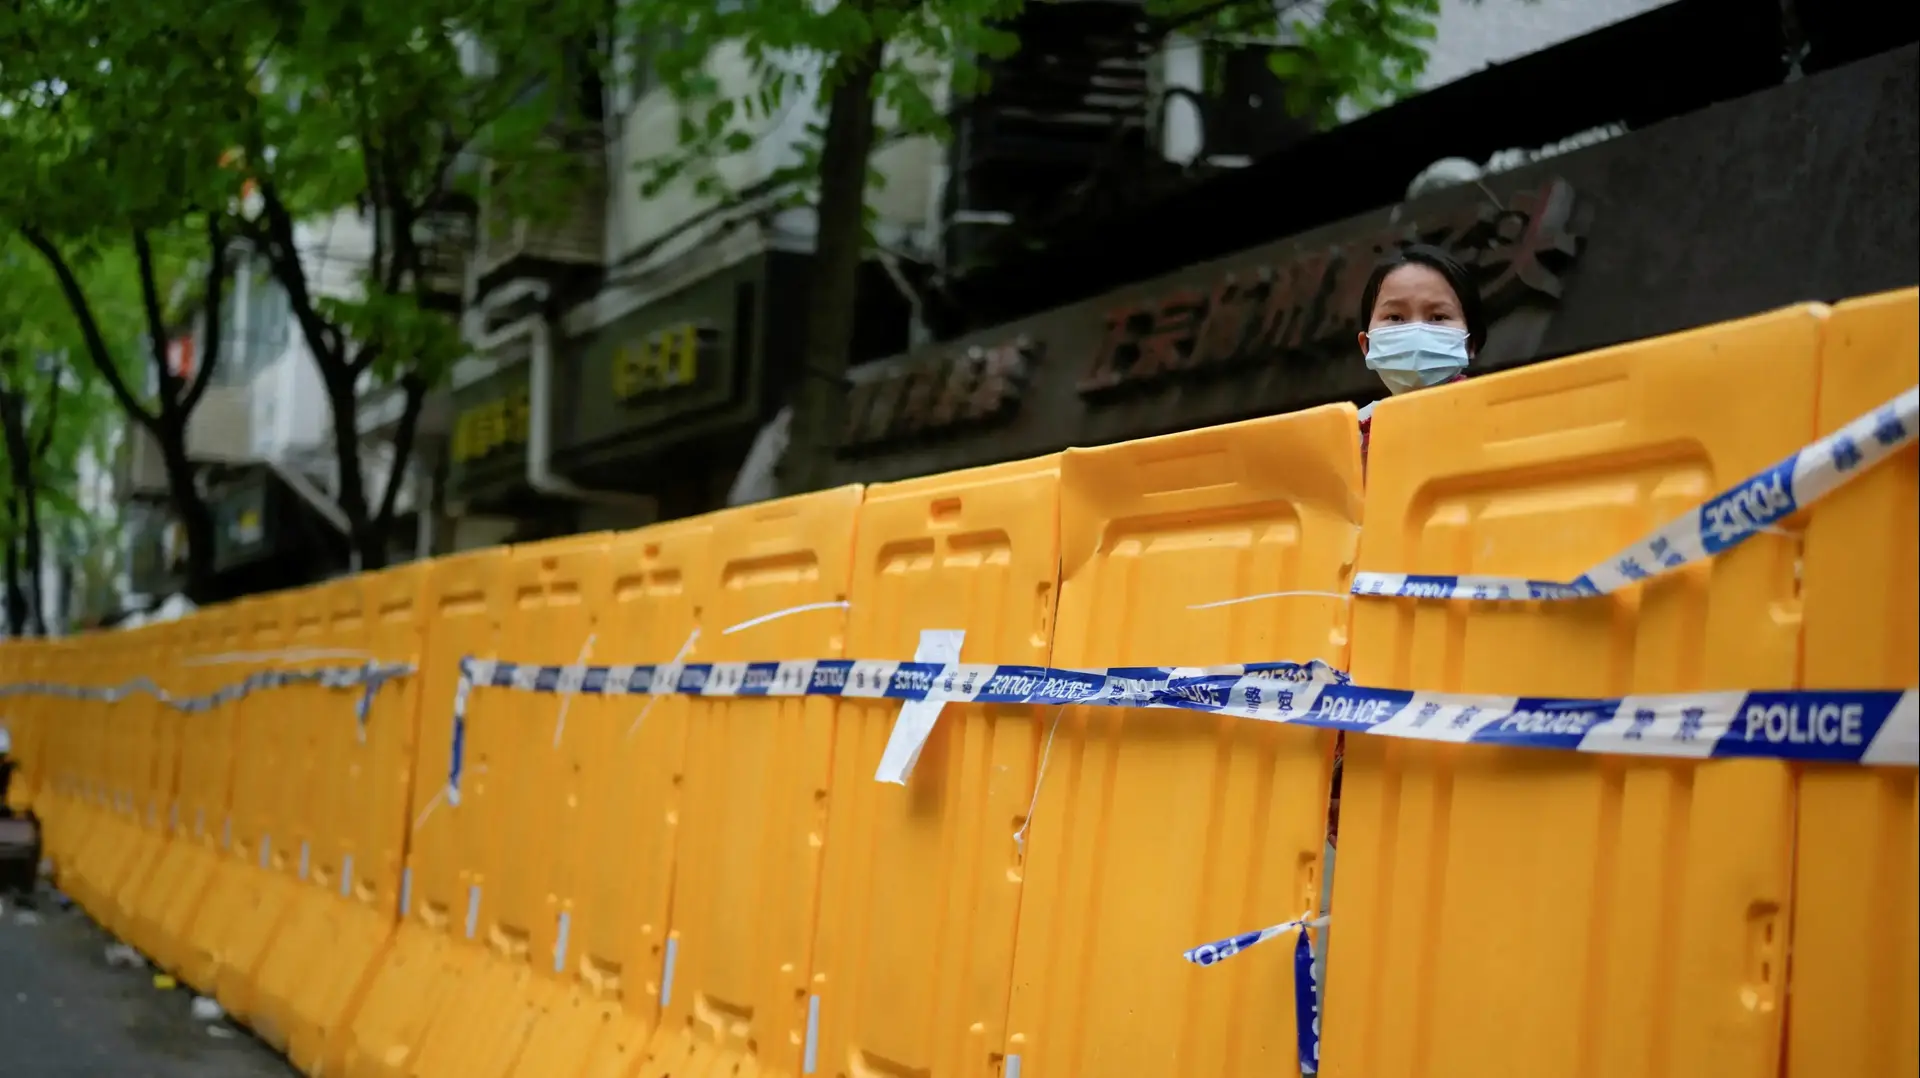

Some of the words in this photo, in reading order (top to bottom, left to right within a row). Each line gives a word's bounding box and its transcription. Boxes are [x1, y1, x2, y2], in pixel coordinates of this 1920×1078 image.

[894, 669, 933, 690] POLICE
[991, 675, 1037, 696] POLICE
[1316, 696, 1391, 724] POLICE
[1500, 710, 1597, 734] POLICE
[1744, 703, 1863, 745] POLICE
